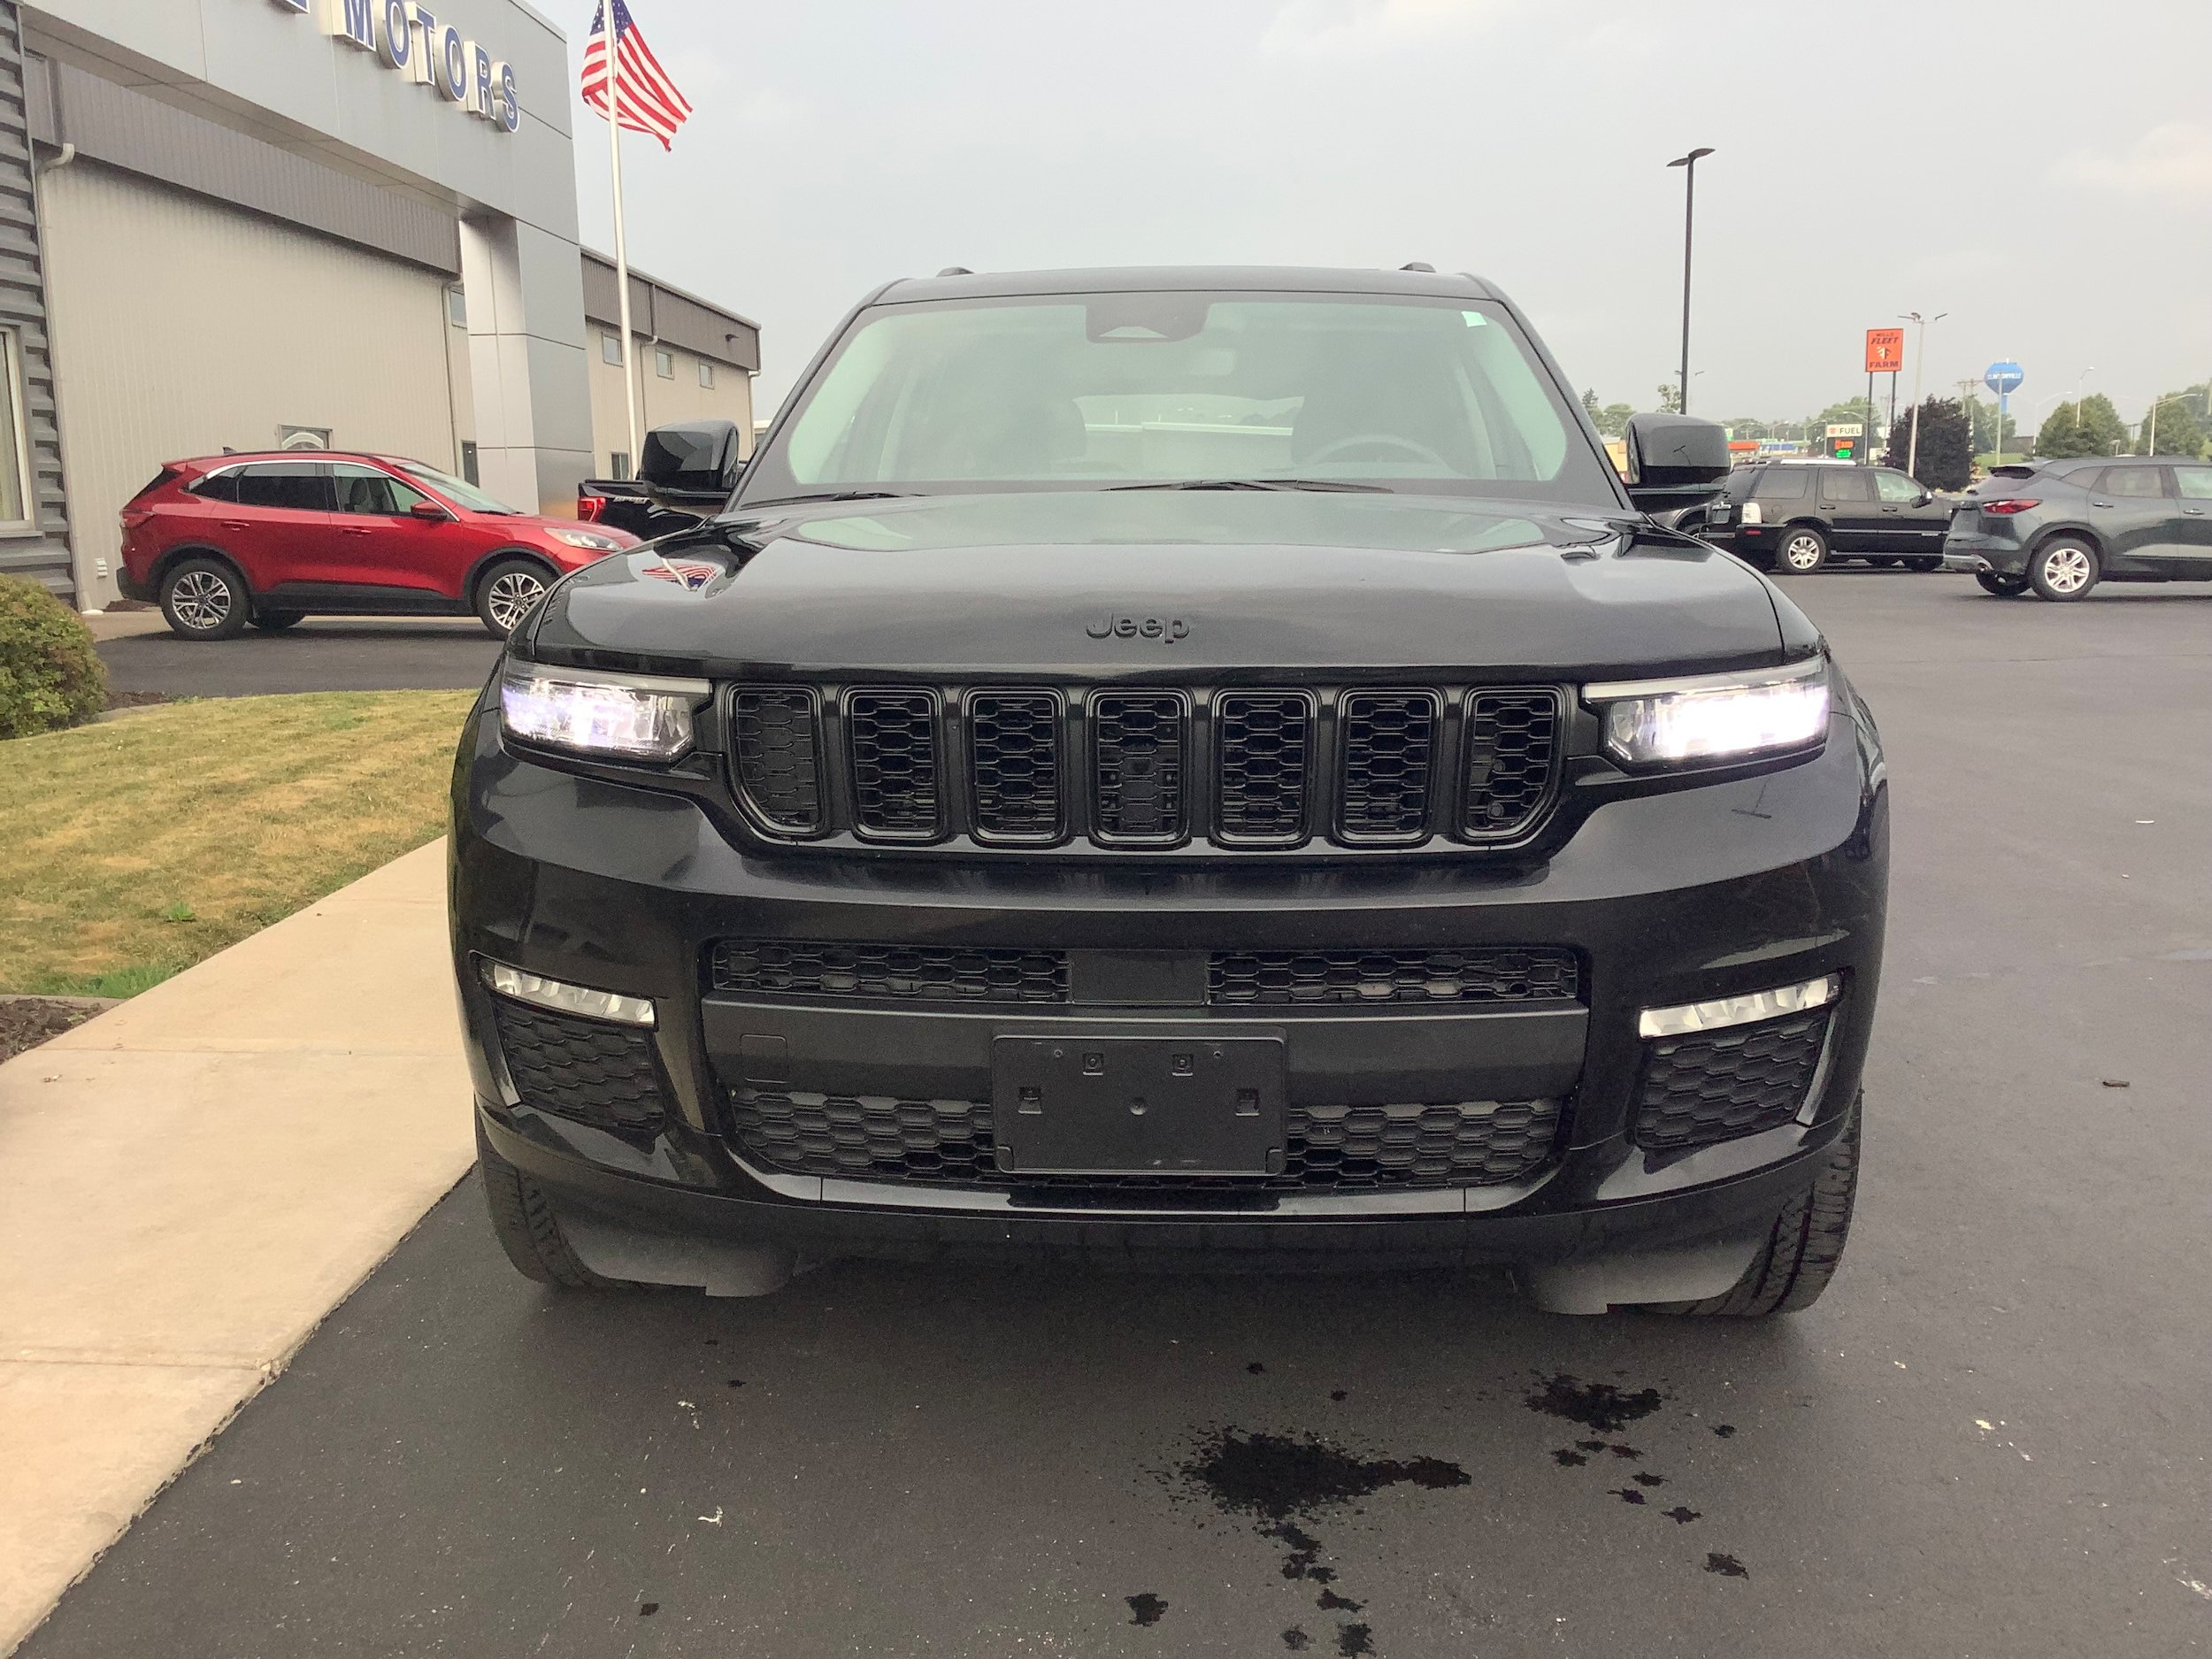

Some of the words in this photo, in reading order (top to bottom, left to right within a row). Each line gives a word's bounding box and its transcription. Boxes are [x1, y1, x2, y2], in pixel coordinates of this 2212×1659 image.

[331, 0, 520, 133] MOTORS
[1870, 336, 1900, 345] FLEET
[1086, 612, 1190, 644] Jeep
